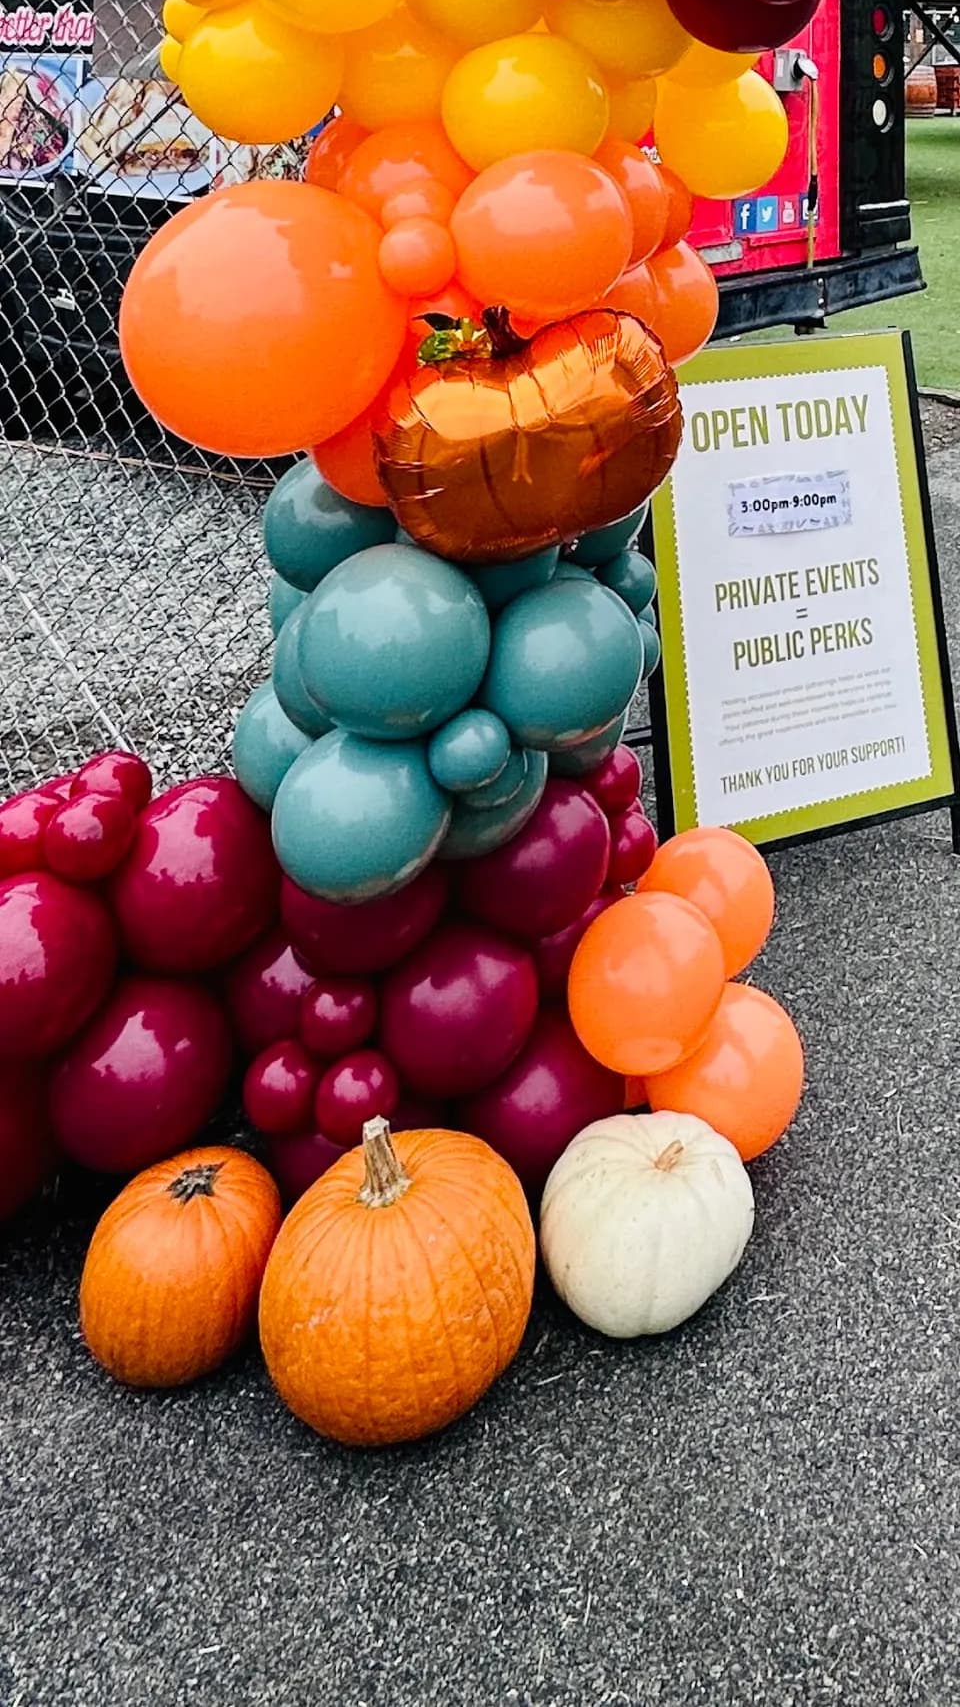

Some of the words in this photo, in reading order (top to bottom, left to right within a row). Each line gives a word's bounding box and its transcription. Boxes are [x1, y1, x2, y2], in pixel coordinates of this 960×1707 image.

[57, 2, 95, 46] tha
[691, 404, 769, 453] OPEN
[776, 394, 868, 442] TODAY
[715, 571, 800, 613] PRIVATE
[805, 558, 880, 596] EVENTS
[733, 630, 805, 671] PUBLIC
[810, 617, 873, 656] PERKS
[720, 768, 763, 795] THANK
[765, 762, 790, 784] YOU
[792, 756, 816, 779] FOR
[817, 748, 849, 772] YOUR
[851, 735, 907, 764] SUPPORT!
